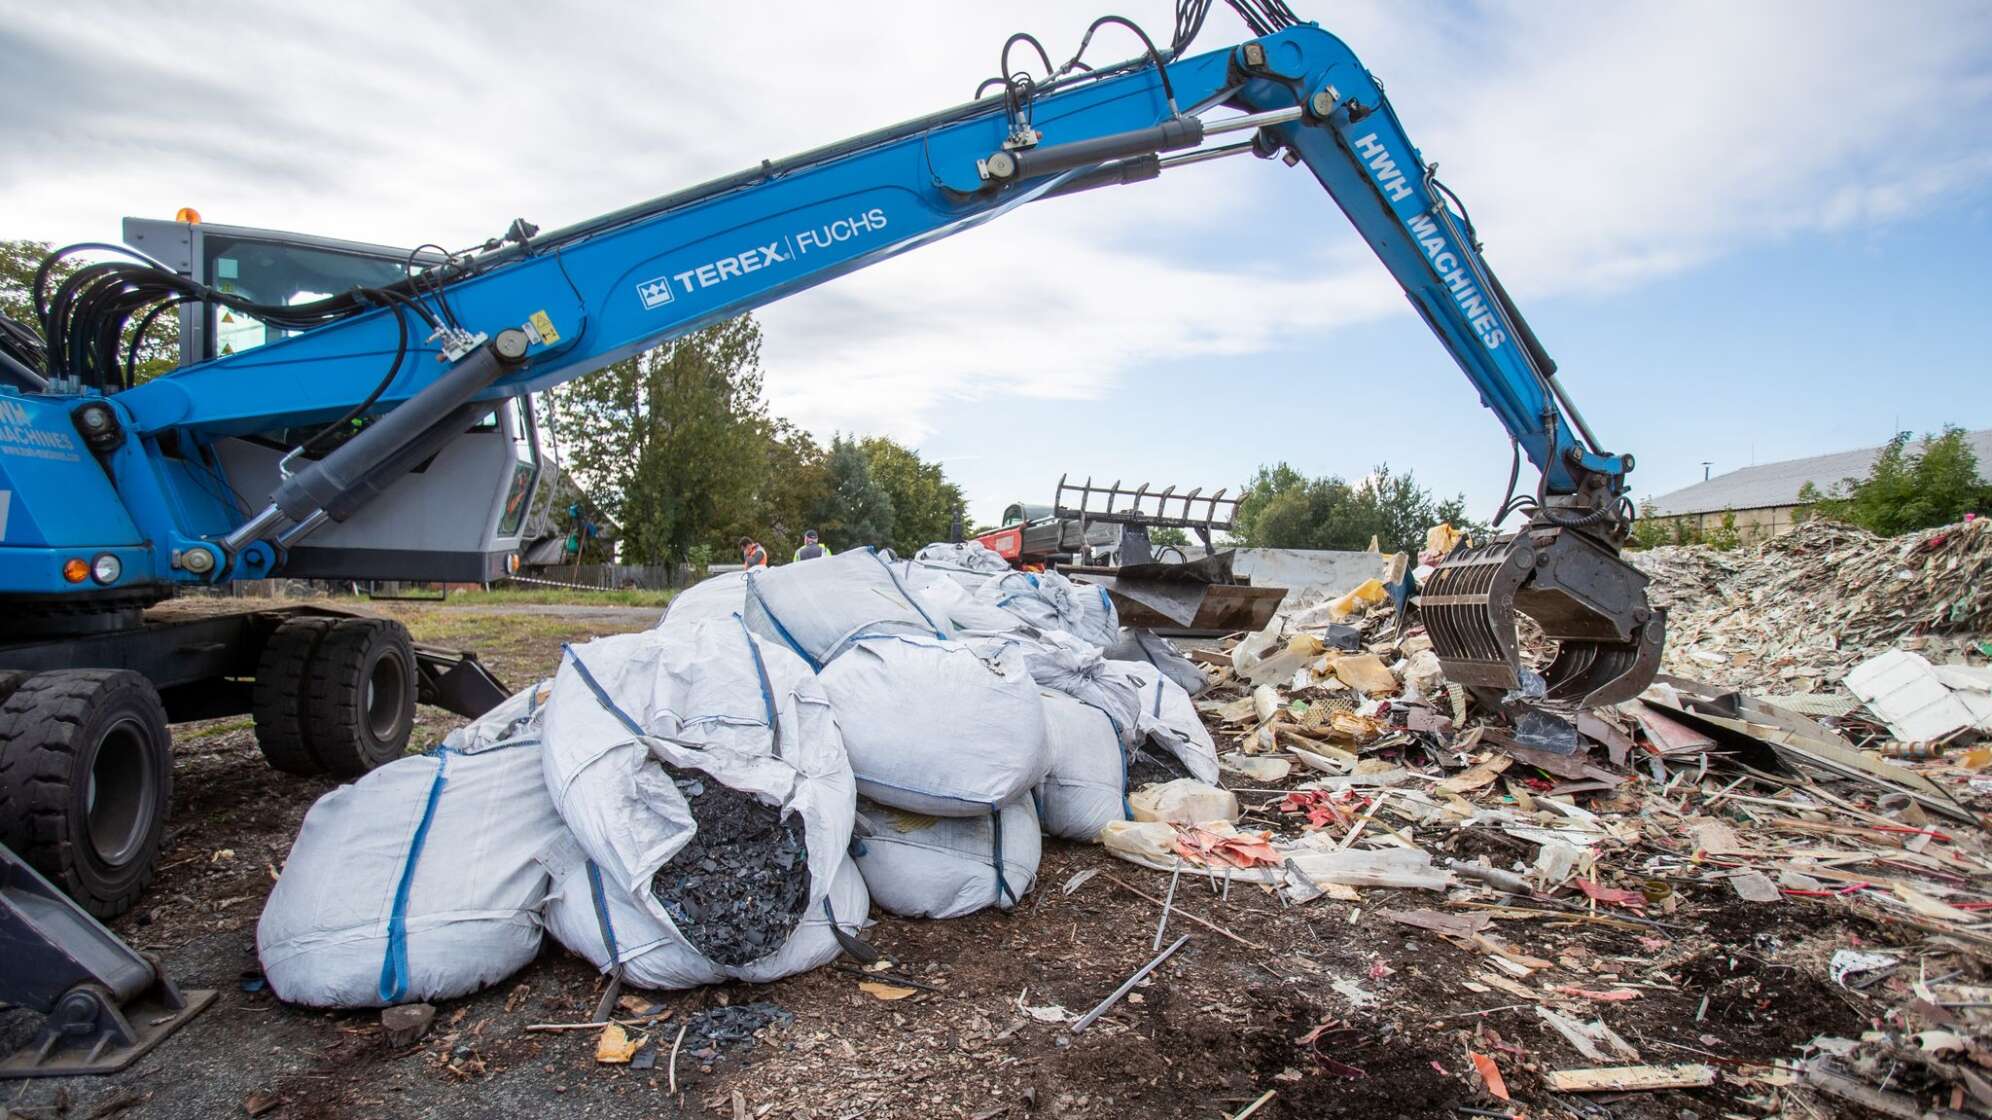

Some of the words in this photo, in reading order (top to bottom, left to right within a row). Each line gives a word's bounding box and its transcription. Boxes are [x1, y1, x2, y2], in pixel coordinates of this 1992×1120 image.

[674, 242, 787, 292] TEREX
[796, 208, 887, 254] FUCHS
[1355, 133, 1413, 202] HWH
[1407, 214, 1505, 350] MACHINES
